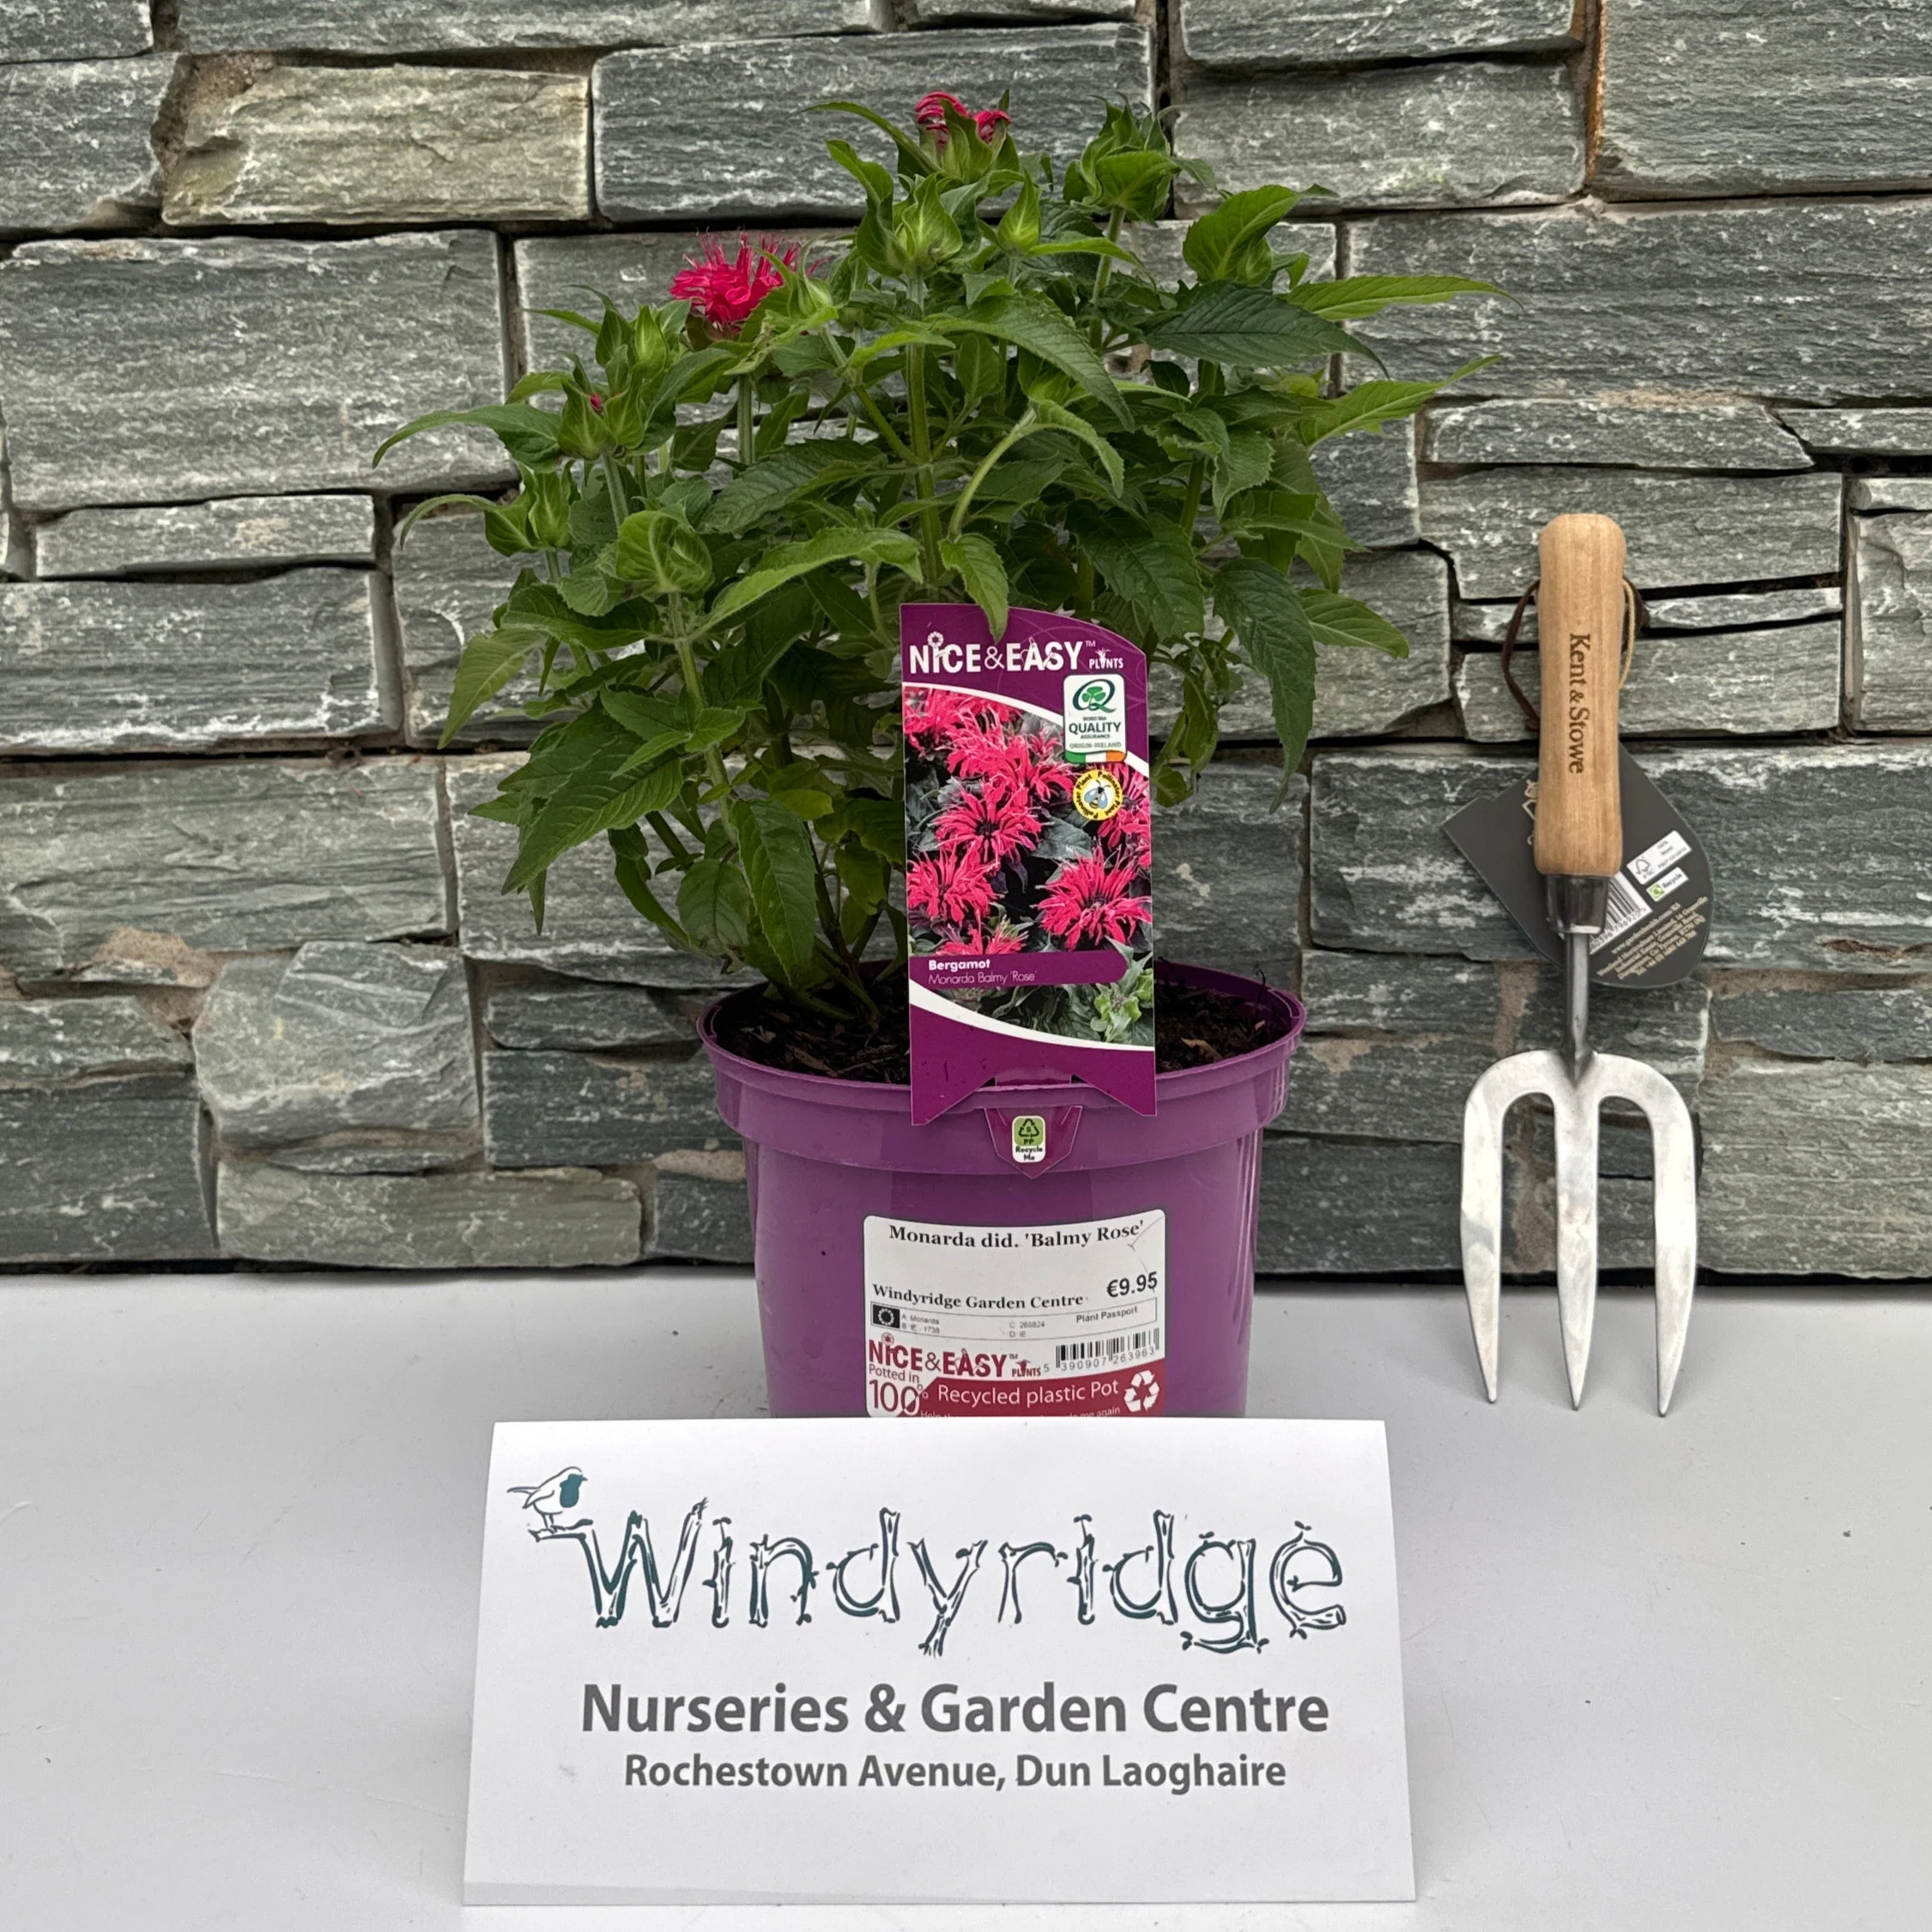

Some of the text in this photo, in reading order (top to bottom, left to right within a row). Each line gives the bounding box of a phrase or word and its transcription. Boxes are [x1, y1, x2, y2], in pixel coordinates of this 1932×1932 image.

[1569, 633, 1590, 774] Kent & Stowe
[1069, 722, 1121, 735] QUALITY
[928, 959, 990, 972] Bergamot
[928, 972, 975, 985] Monarda
[978, 972, 1008, 985] Balmy
[888, 1219, 1145, 1248] Monarda did. 'Balmy Rose'
[872, 1283, 1084, 1309] Windyridge Garden Centre
[1105, 1271, 1158, 1298] €9.95
[910, 1315, 940, 1324] Monarda
[1075, 1305, 1138, 1323] Plant Passport
[1044, 1346, 1154, 1372] 5 390907 263963
[869, 1363, 920, 1384] Potted in
[938, 1379, 1119, 1408] Recycled plastic Pot
[529, 1497, 1347, 1657] Windyridge
[582, 1681, 1329, 1733] Nurseries & Garden Centre
[625, 1753, 1287, 1796] Rochestown Avenue, Dun Laoghaire
